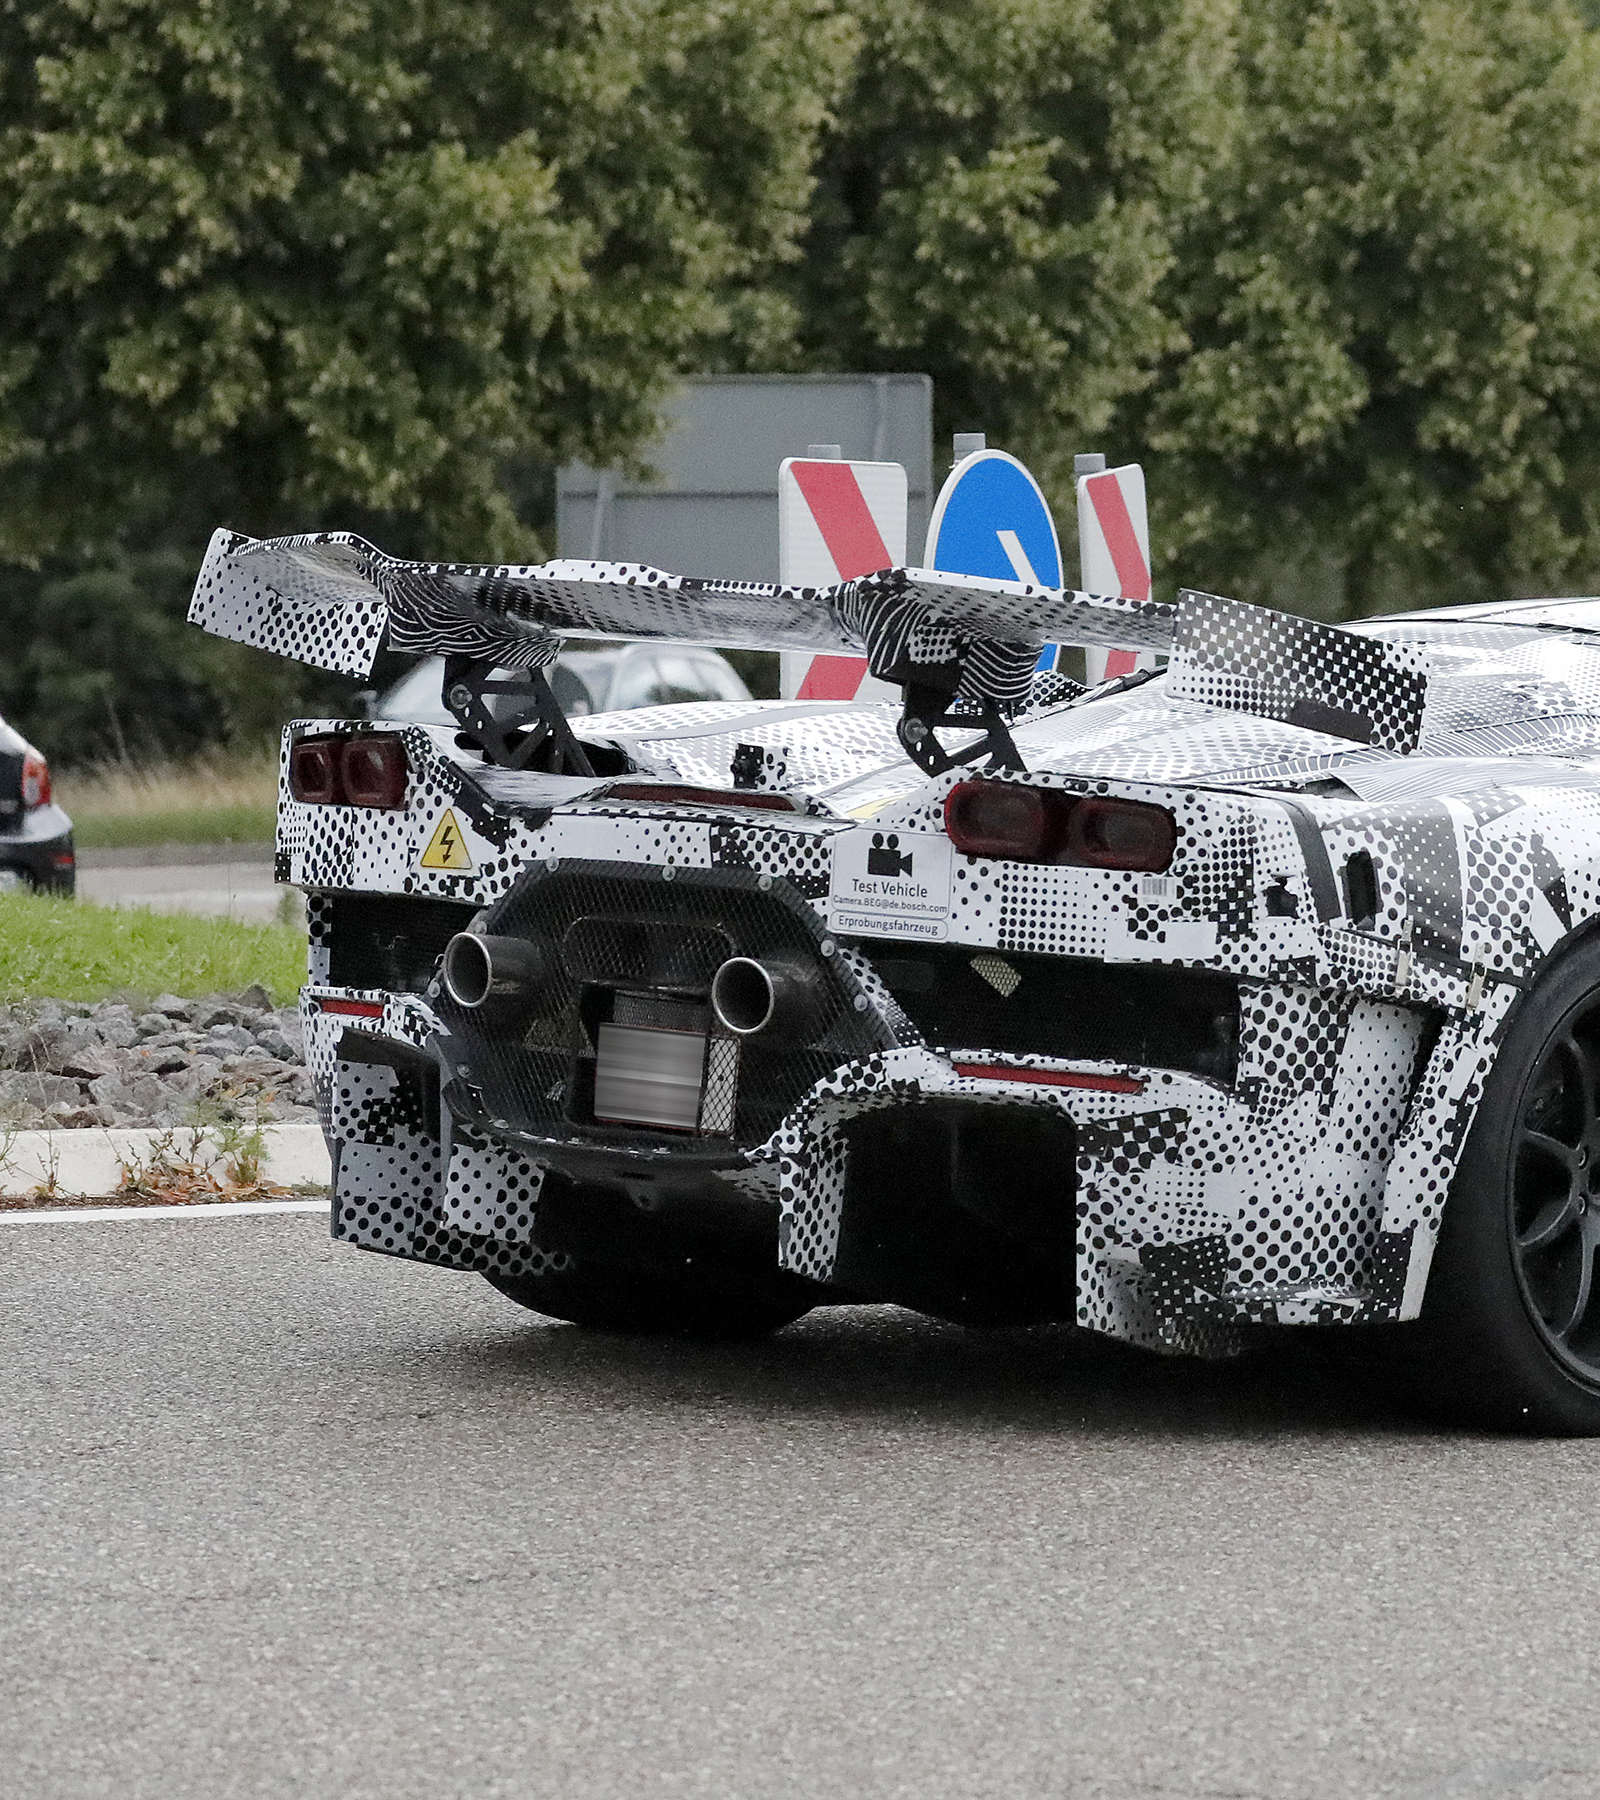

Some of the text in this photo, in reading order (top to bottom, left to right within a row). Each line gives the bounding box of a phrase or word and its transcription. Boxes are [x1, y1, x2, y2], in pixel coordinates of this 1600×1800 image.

[852, 878, 928, 898] Test Vehicle
[833, 895, 948, 913] Camera.BEG@de.bosch.com
[839, 915, 938, 936] Erprobungsfahrzeug
